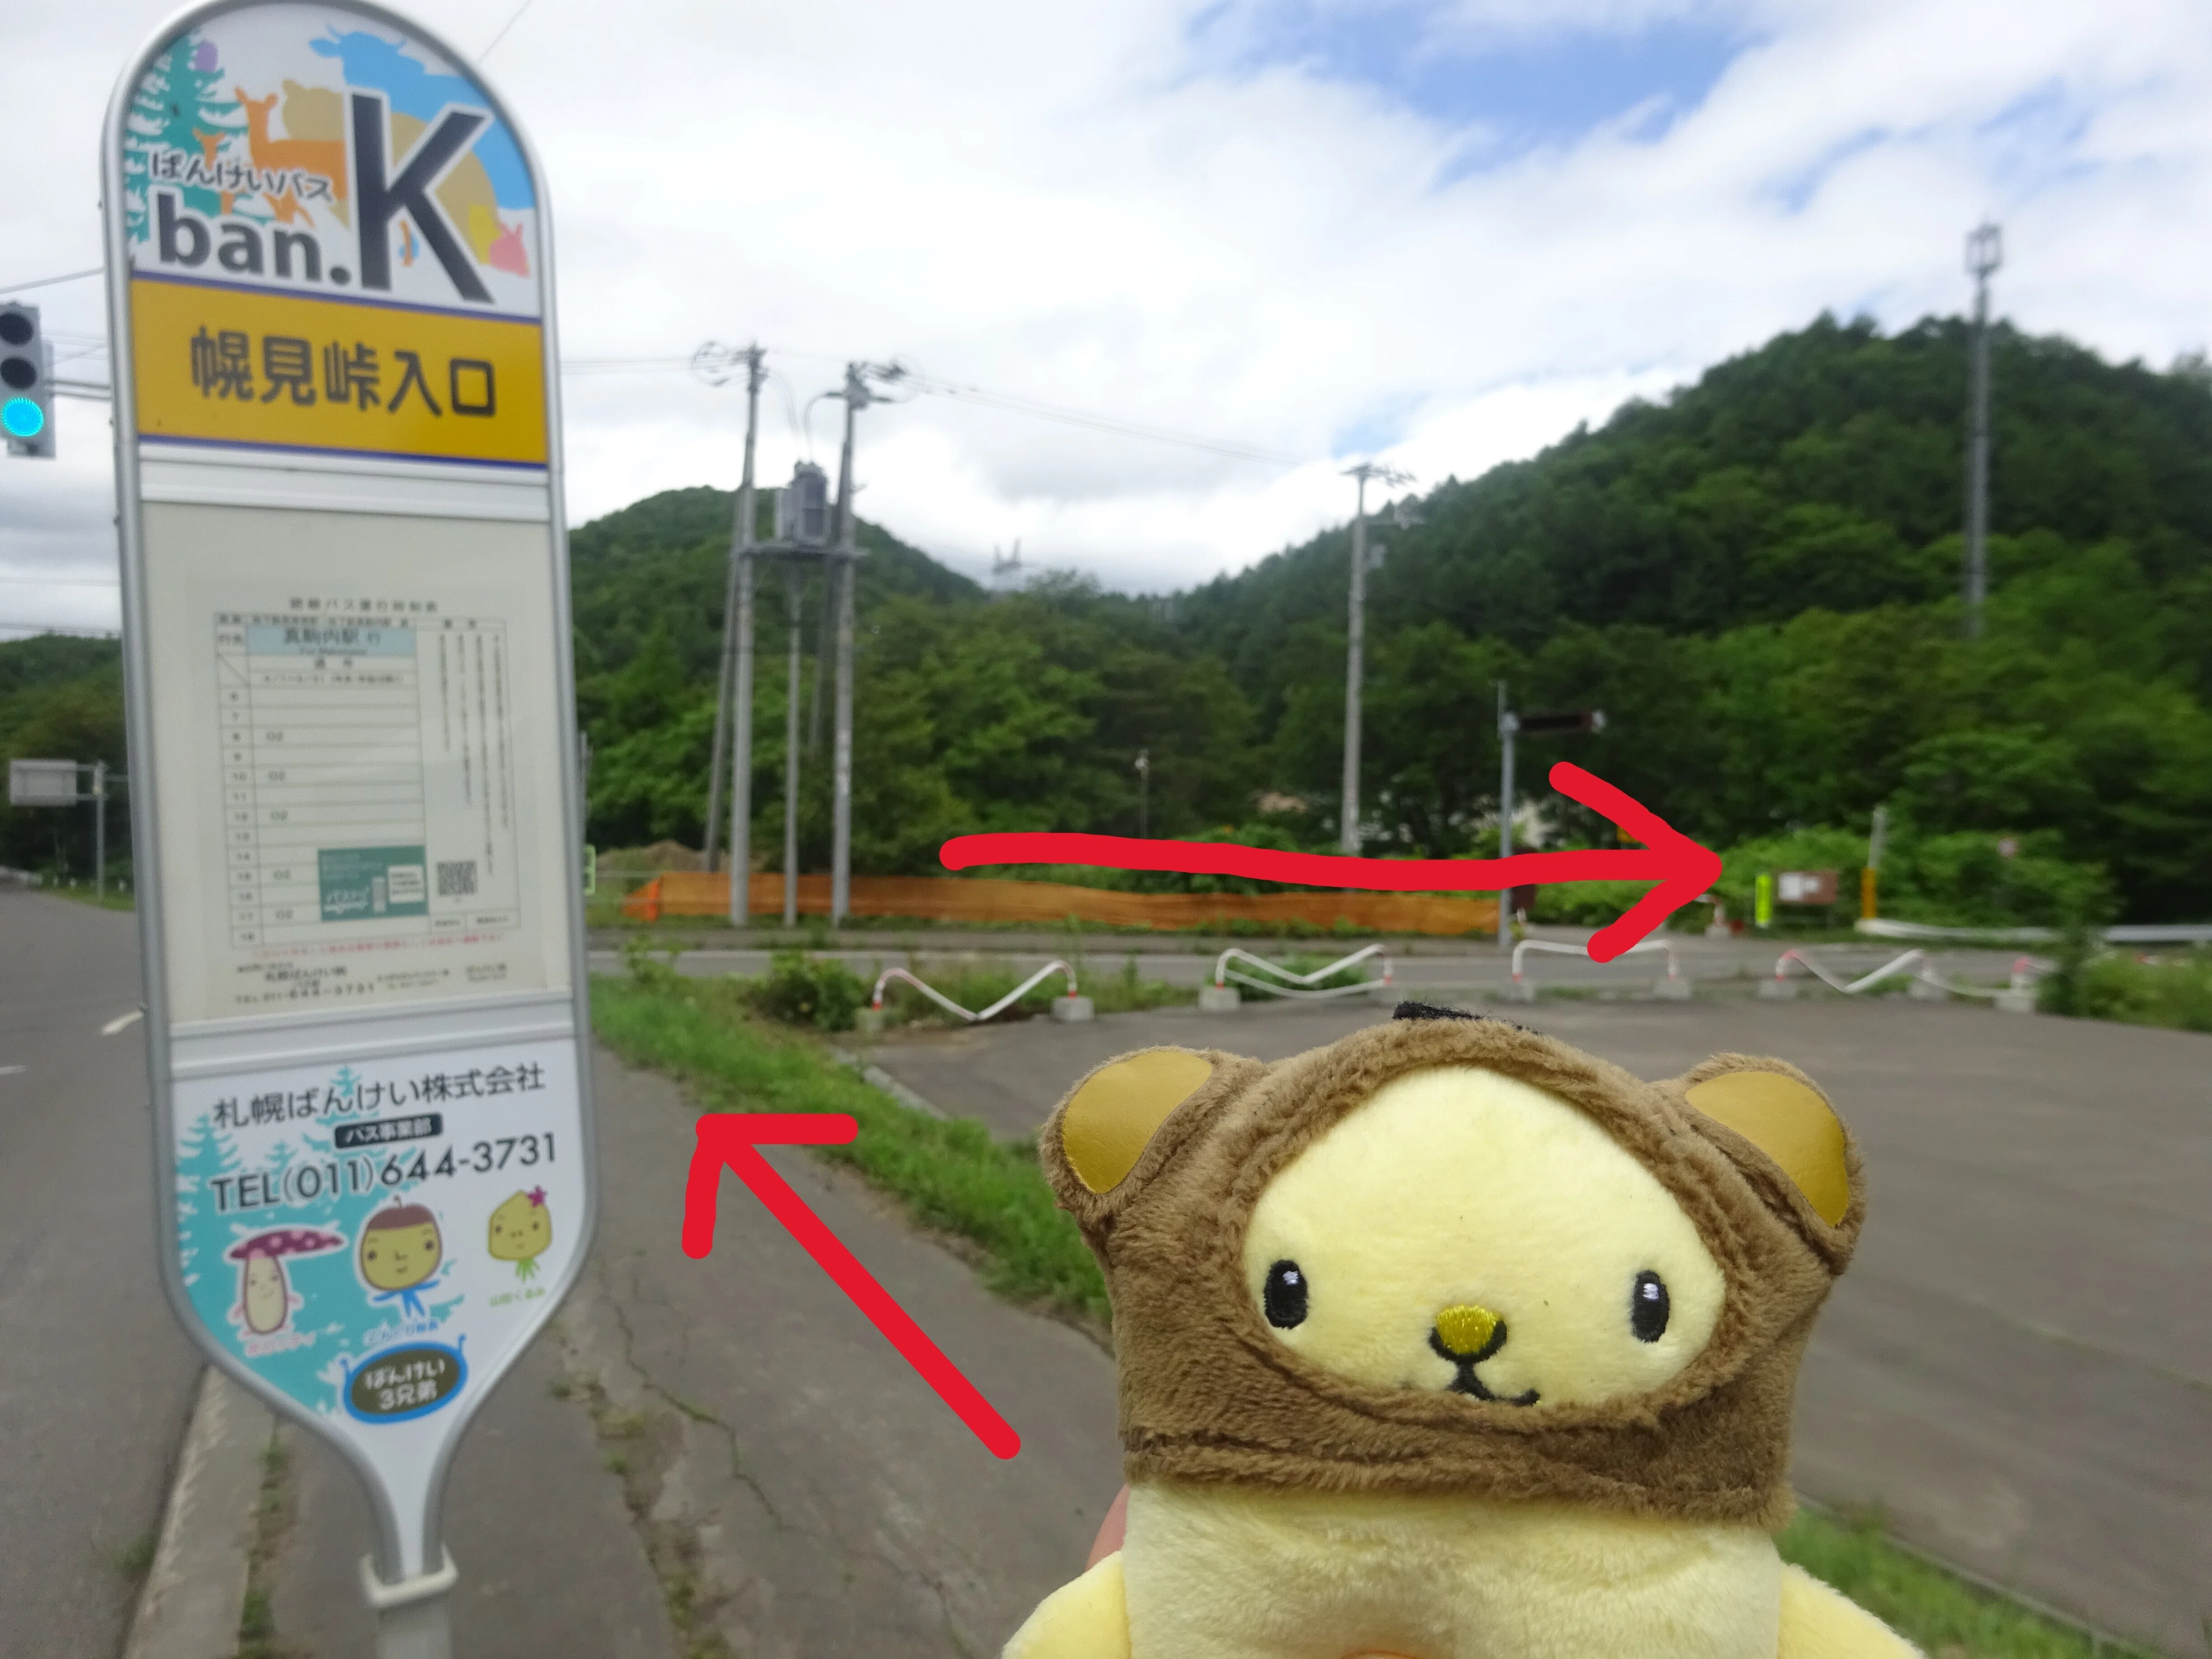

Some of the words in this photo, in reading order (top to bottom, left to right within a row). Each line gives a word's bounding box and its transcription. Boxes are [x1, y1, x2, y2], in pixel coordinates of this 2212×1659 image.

[151, 150, 337, 202] ばんけいバス
[191, 326, 497, 419] 幌見峠入口
[213, 1062, 546, 1130] 札幌ばんけい株式会社
[344, 1117, 433, 1144] バス事業部
[364, 1359, 445, 1390] ばんけい
[379, 1379, 438, 1411] 3兄弟
